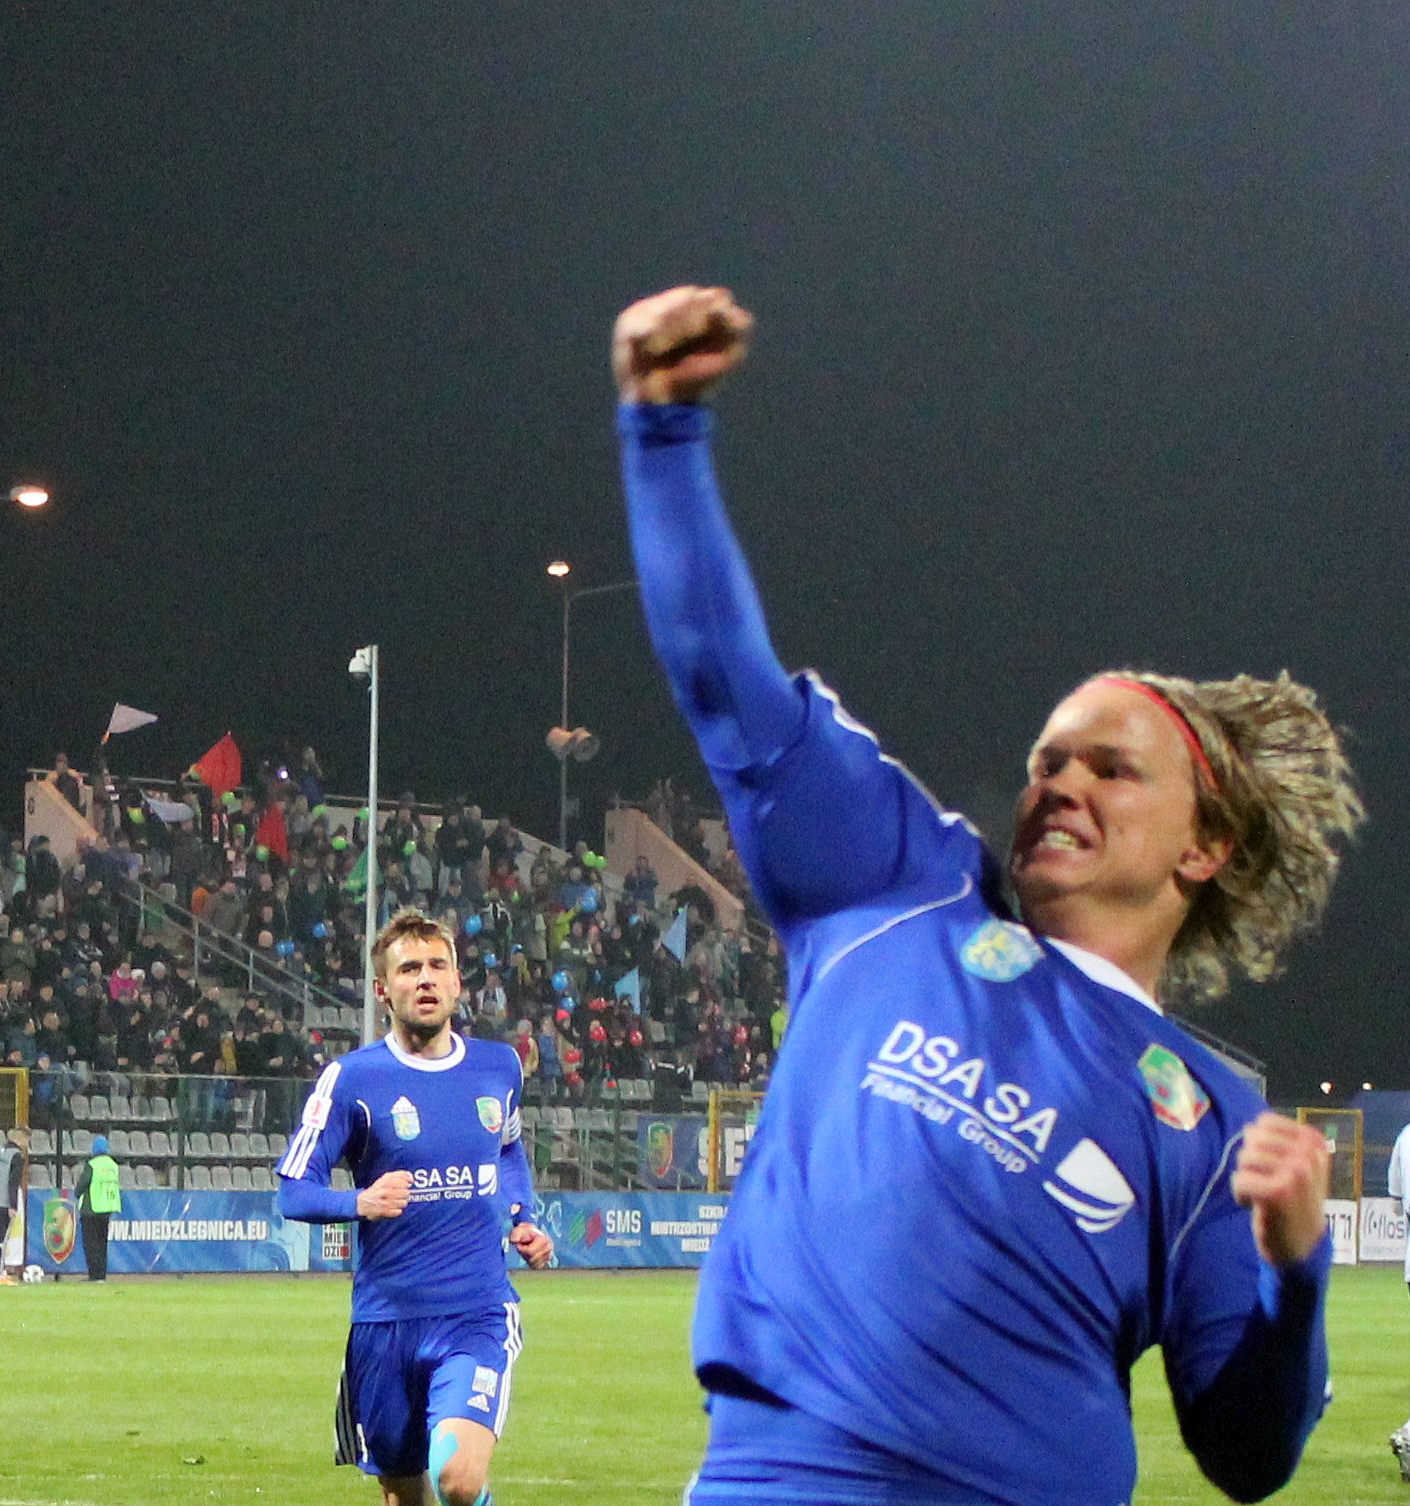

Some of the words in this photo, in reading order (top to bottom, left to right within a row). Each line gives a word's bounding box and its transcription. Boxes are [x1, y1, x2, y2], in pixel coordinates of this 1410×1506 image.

[877, 1019, 985, 1099] DSA
[983, 1082, 1059, 1153] SA
[957, 1117, 1028, 1174] Group
[409, 1168, 443, 1189] SA
[445, 1165, 473, 1186] SA
[407, 1192, 441, 1203] nancial
[444, 1190, 473, 1201] Group
[606, 1209, 641, 1234] SMS
